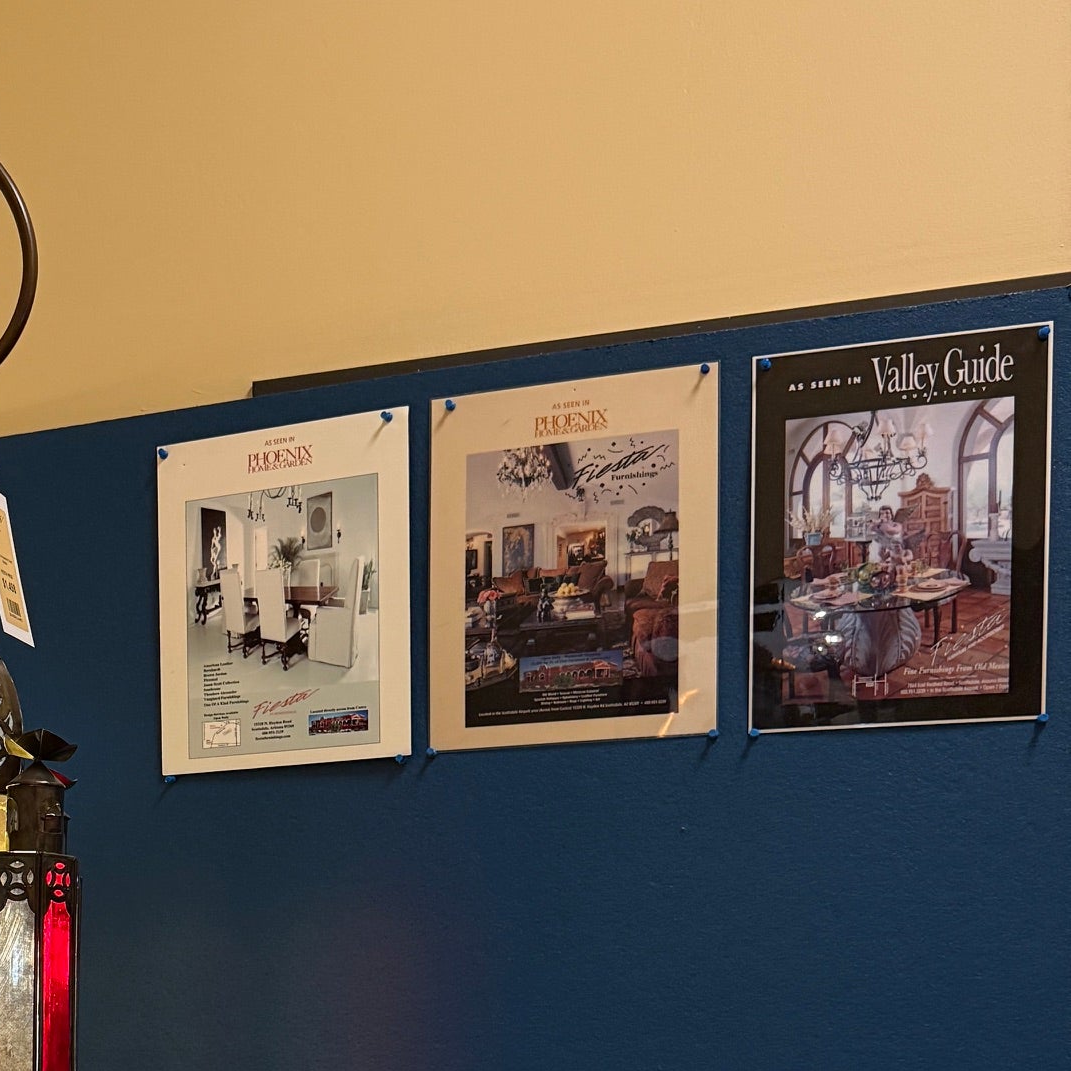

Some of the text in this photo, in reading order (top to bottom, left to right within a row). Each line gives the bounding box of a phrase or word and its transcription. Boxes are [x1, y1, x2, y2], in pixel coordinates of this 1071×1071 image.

[871, 342, 1014, 402] Valley Guide
[788, 376, 861, 392] AS SEEN IN
[901, 386, 987, 400] QUARTERLY
[552, 402, 561, 410] AS
[563, 400, 580, 409] SEEN
[535, 408, 608, 431] PHOENIX
[273, 437, 288, 445] SEEN
[248, 444, 313, 467] PHOENIX
[572, 444, 665, 490] Fiesta
[611, 470, 658, 481] Furnishings
[930, 608, 1008, 667] Fiesta
[903, 667, 917, 676] Fine
[956, 663, 972, 672] From
[974, 661, 988, 671] Old
[252, 687, 320, 719] Fiesta
